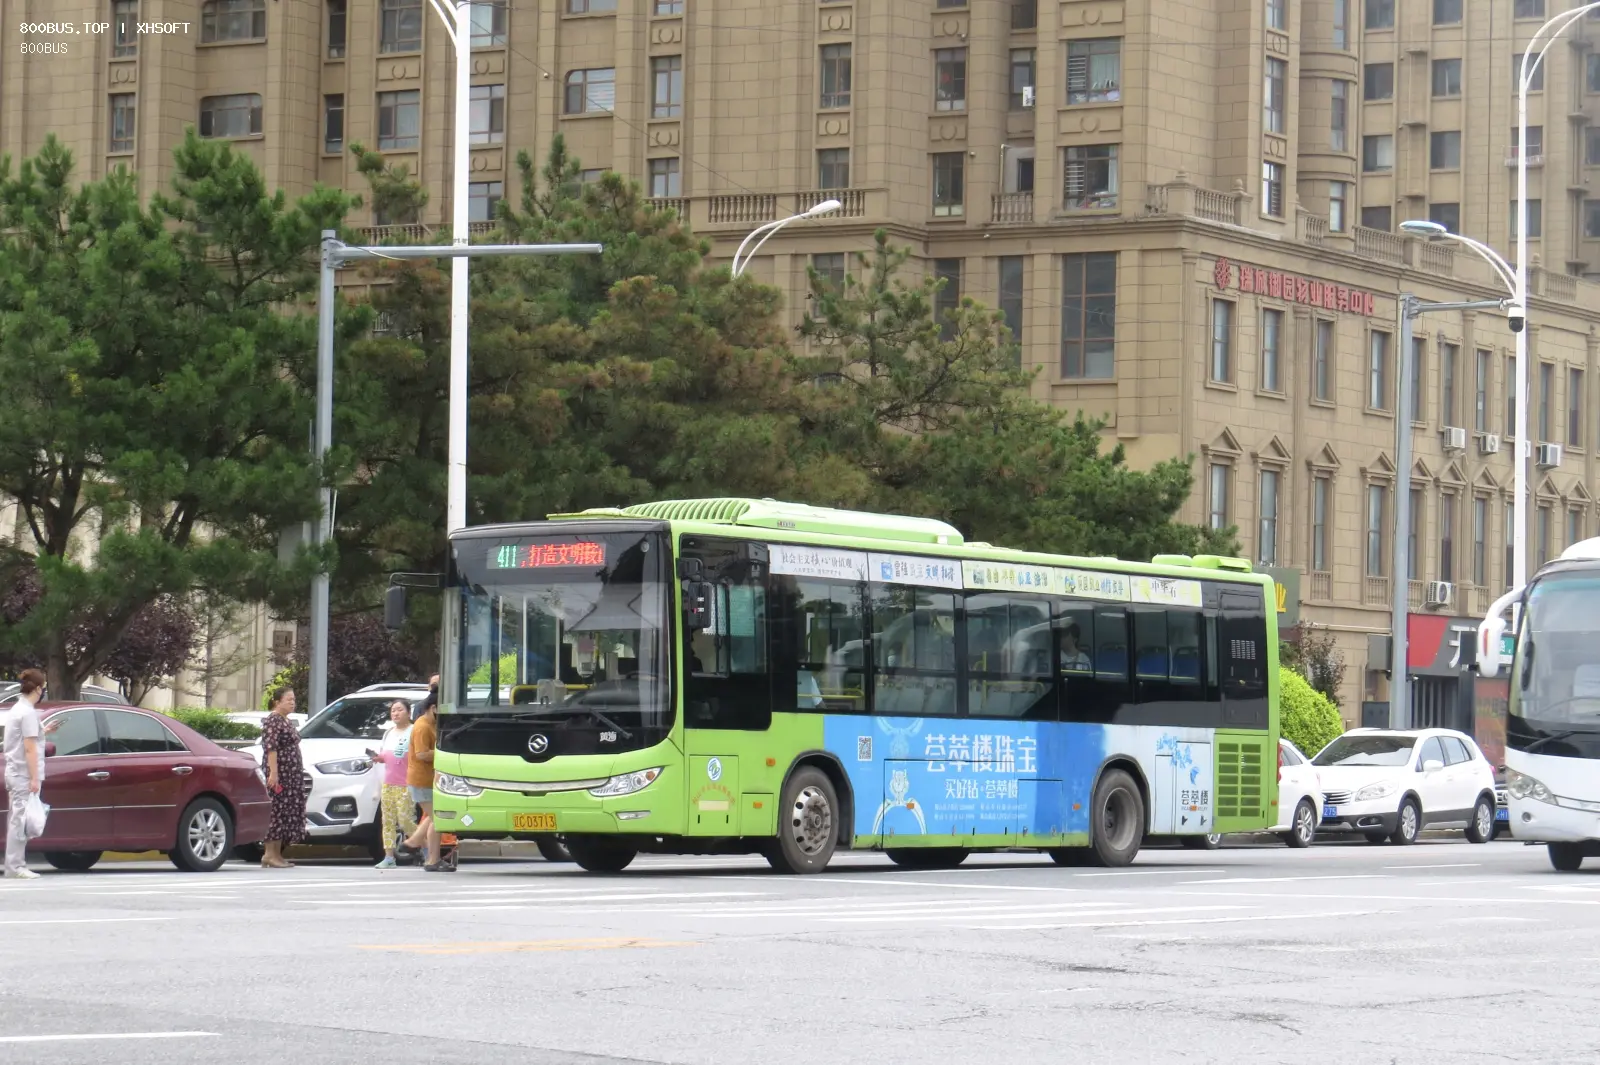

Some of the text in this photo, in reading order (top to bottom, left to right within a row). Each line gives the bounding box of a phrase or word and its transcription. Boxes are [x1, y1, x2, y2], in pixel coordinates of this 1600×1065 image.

[497, 545, 517, 568] 411
[924, 733, 1038, 773] 荟萃楼珠宝
[1181, 789, 1209, 805] 荟萃楼
